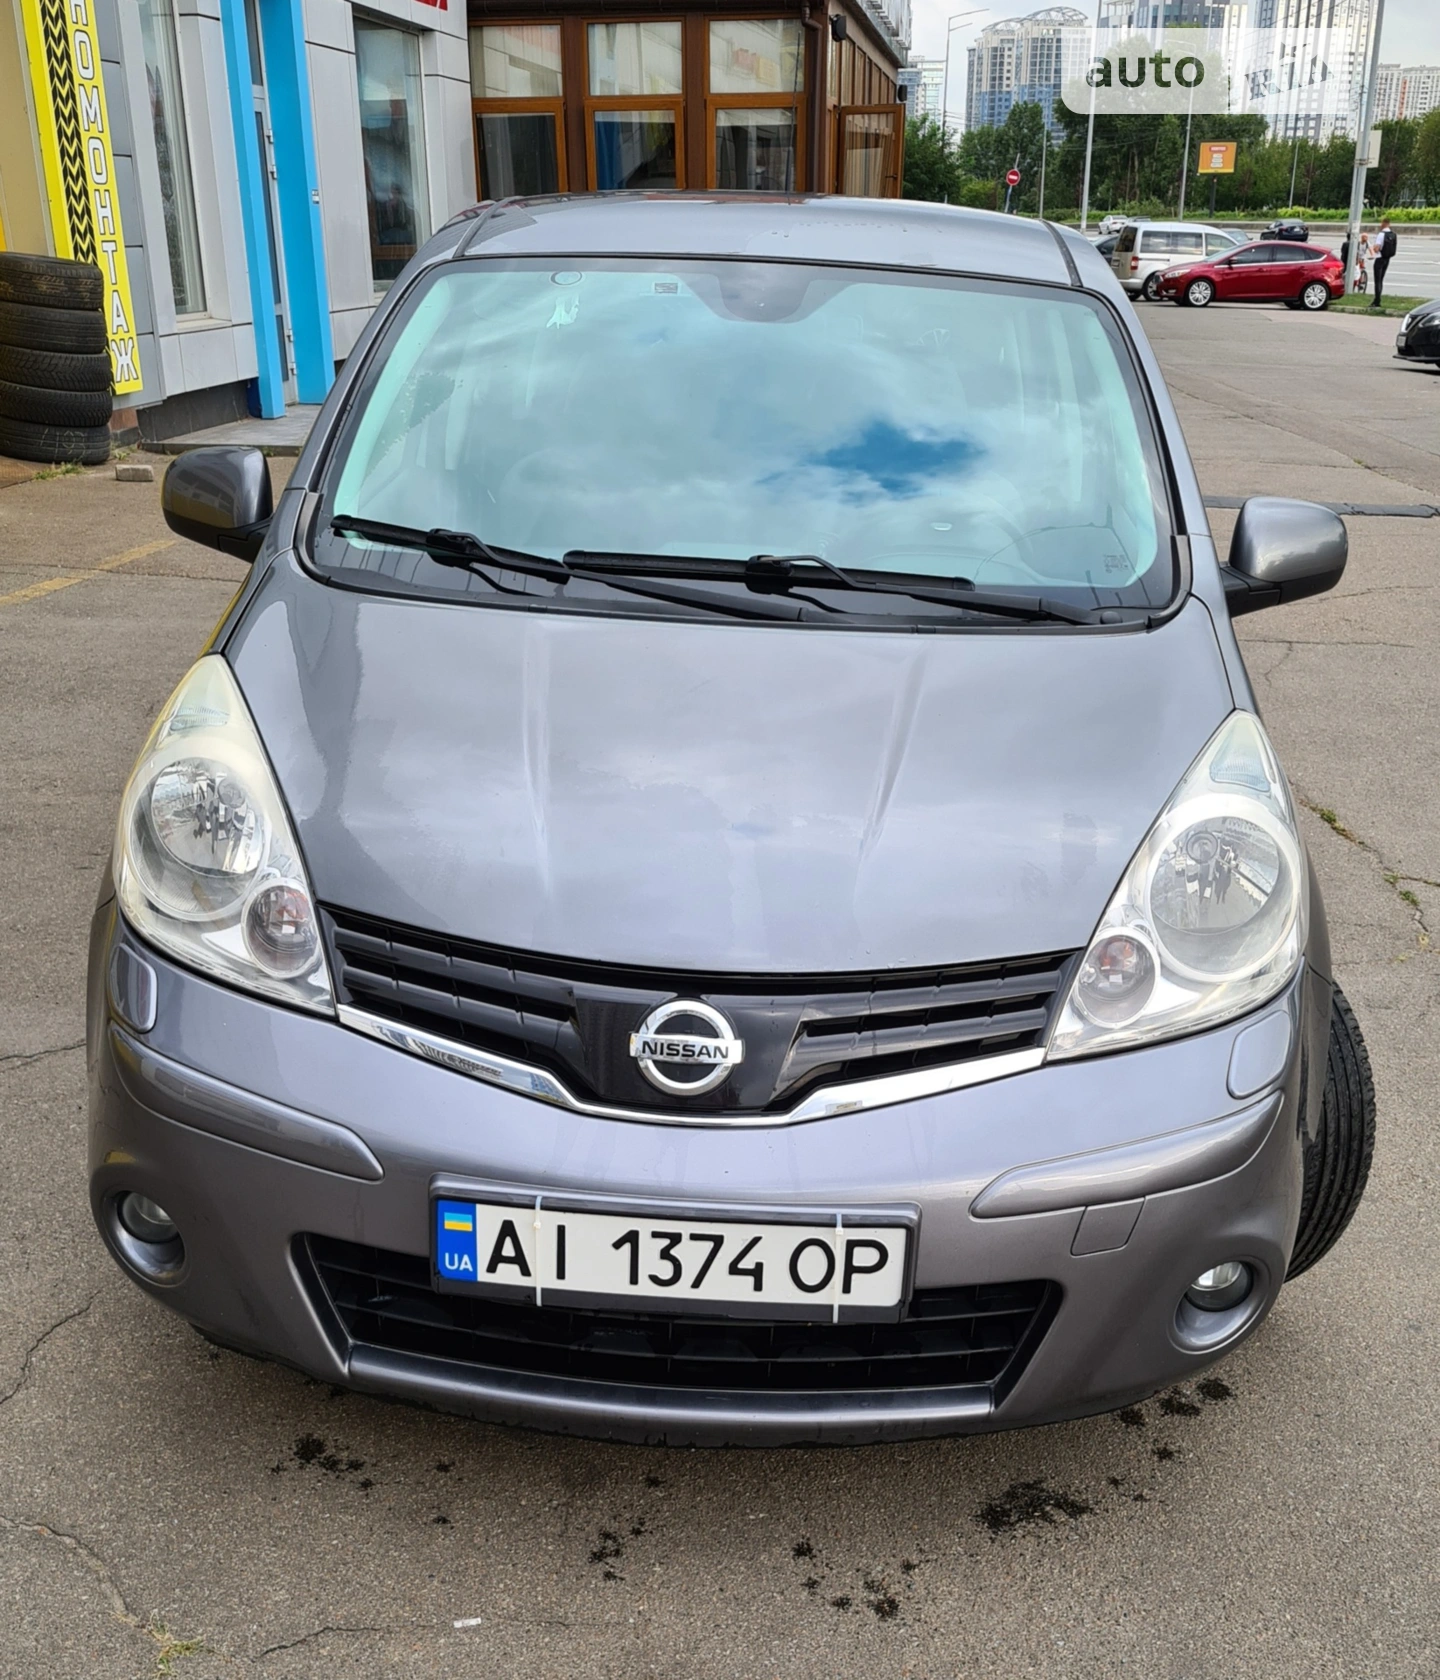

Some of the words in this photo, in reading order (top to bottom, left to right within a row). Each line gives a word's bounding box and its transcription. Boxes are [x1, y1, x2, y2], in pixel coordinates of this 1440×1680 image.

[641, 1040, 730, 1060] NISSAN
[444, 1253, 474, 1272] UA
[485, 1219, 566, 1281] AI
[611, 1229, 765, 1292] 1374
[788, 1237, 890, 1295] OP
